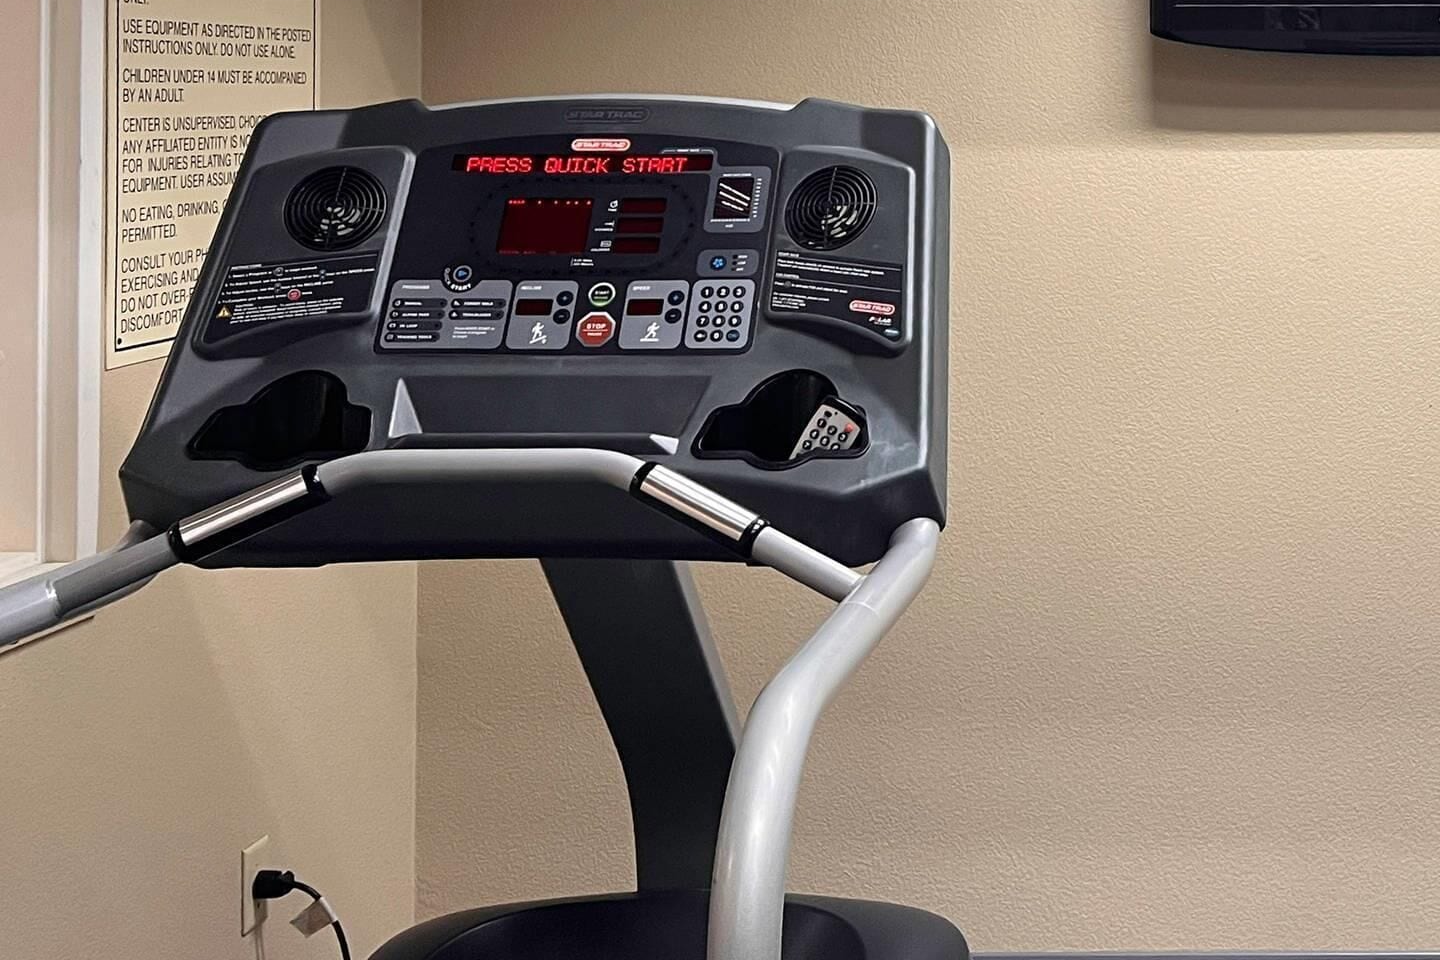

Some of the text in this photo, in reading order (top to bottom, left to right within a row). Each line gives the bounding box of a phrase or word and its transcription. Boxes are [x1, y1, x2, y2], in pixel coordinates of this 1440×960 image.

[122, 19, 312, 42] USE EQUIPMENT AS DIRECTED IN THE POSTED
[122, 39, 193, 56] INSTRUCTIONS
[195, 42, 219, 57] ONLY.
[220, 43, 233, 57] DO
[235, 43, 252, 57] NOT
[254, 44, 269, 58] USE
[122, 68, 307, 85] CHILDREN UNDER 14 MUST BE ACCOMPANIED
[122, 88, 184, 103] BY AN ADULT.
[567, 110, 644, 119] STAR TRAC
[122, 117, 160, 133] CENTER
[163, 117, 171, 132] IS
[122, 140, 143, 155] ANY
[145, 137, 196, 153] AFFILIATED
[198, 136, 229, 151] ENTITY
[230, 135, 238, 149] IS
[122, 158, 143, 174] FOR
[148, 156, 188, 172] INJURIES
[191, 153, 232, 169] RELATING
[466, 157, 688, 173] PRESS QUICK START
[122, 175, 178, 194] EQUIPMENT.
[180, 174, 205, 189] USER
[122, 208, 137, 223] NO
[122, 223, 177, 243] PERMITTED.
[121, 253, 167, 274] CONSULT
[168, 250, 194, 266] YOUR
[121, 268, 199, 294] EXERCISING AND
[121, 297, 136, 314] DO
[138, 293, 159, 310] NOT
